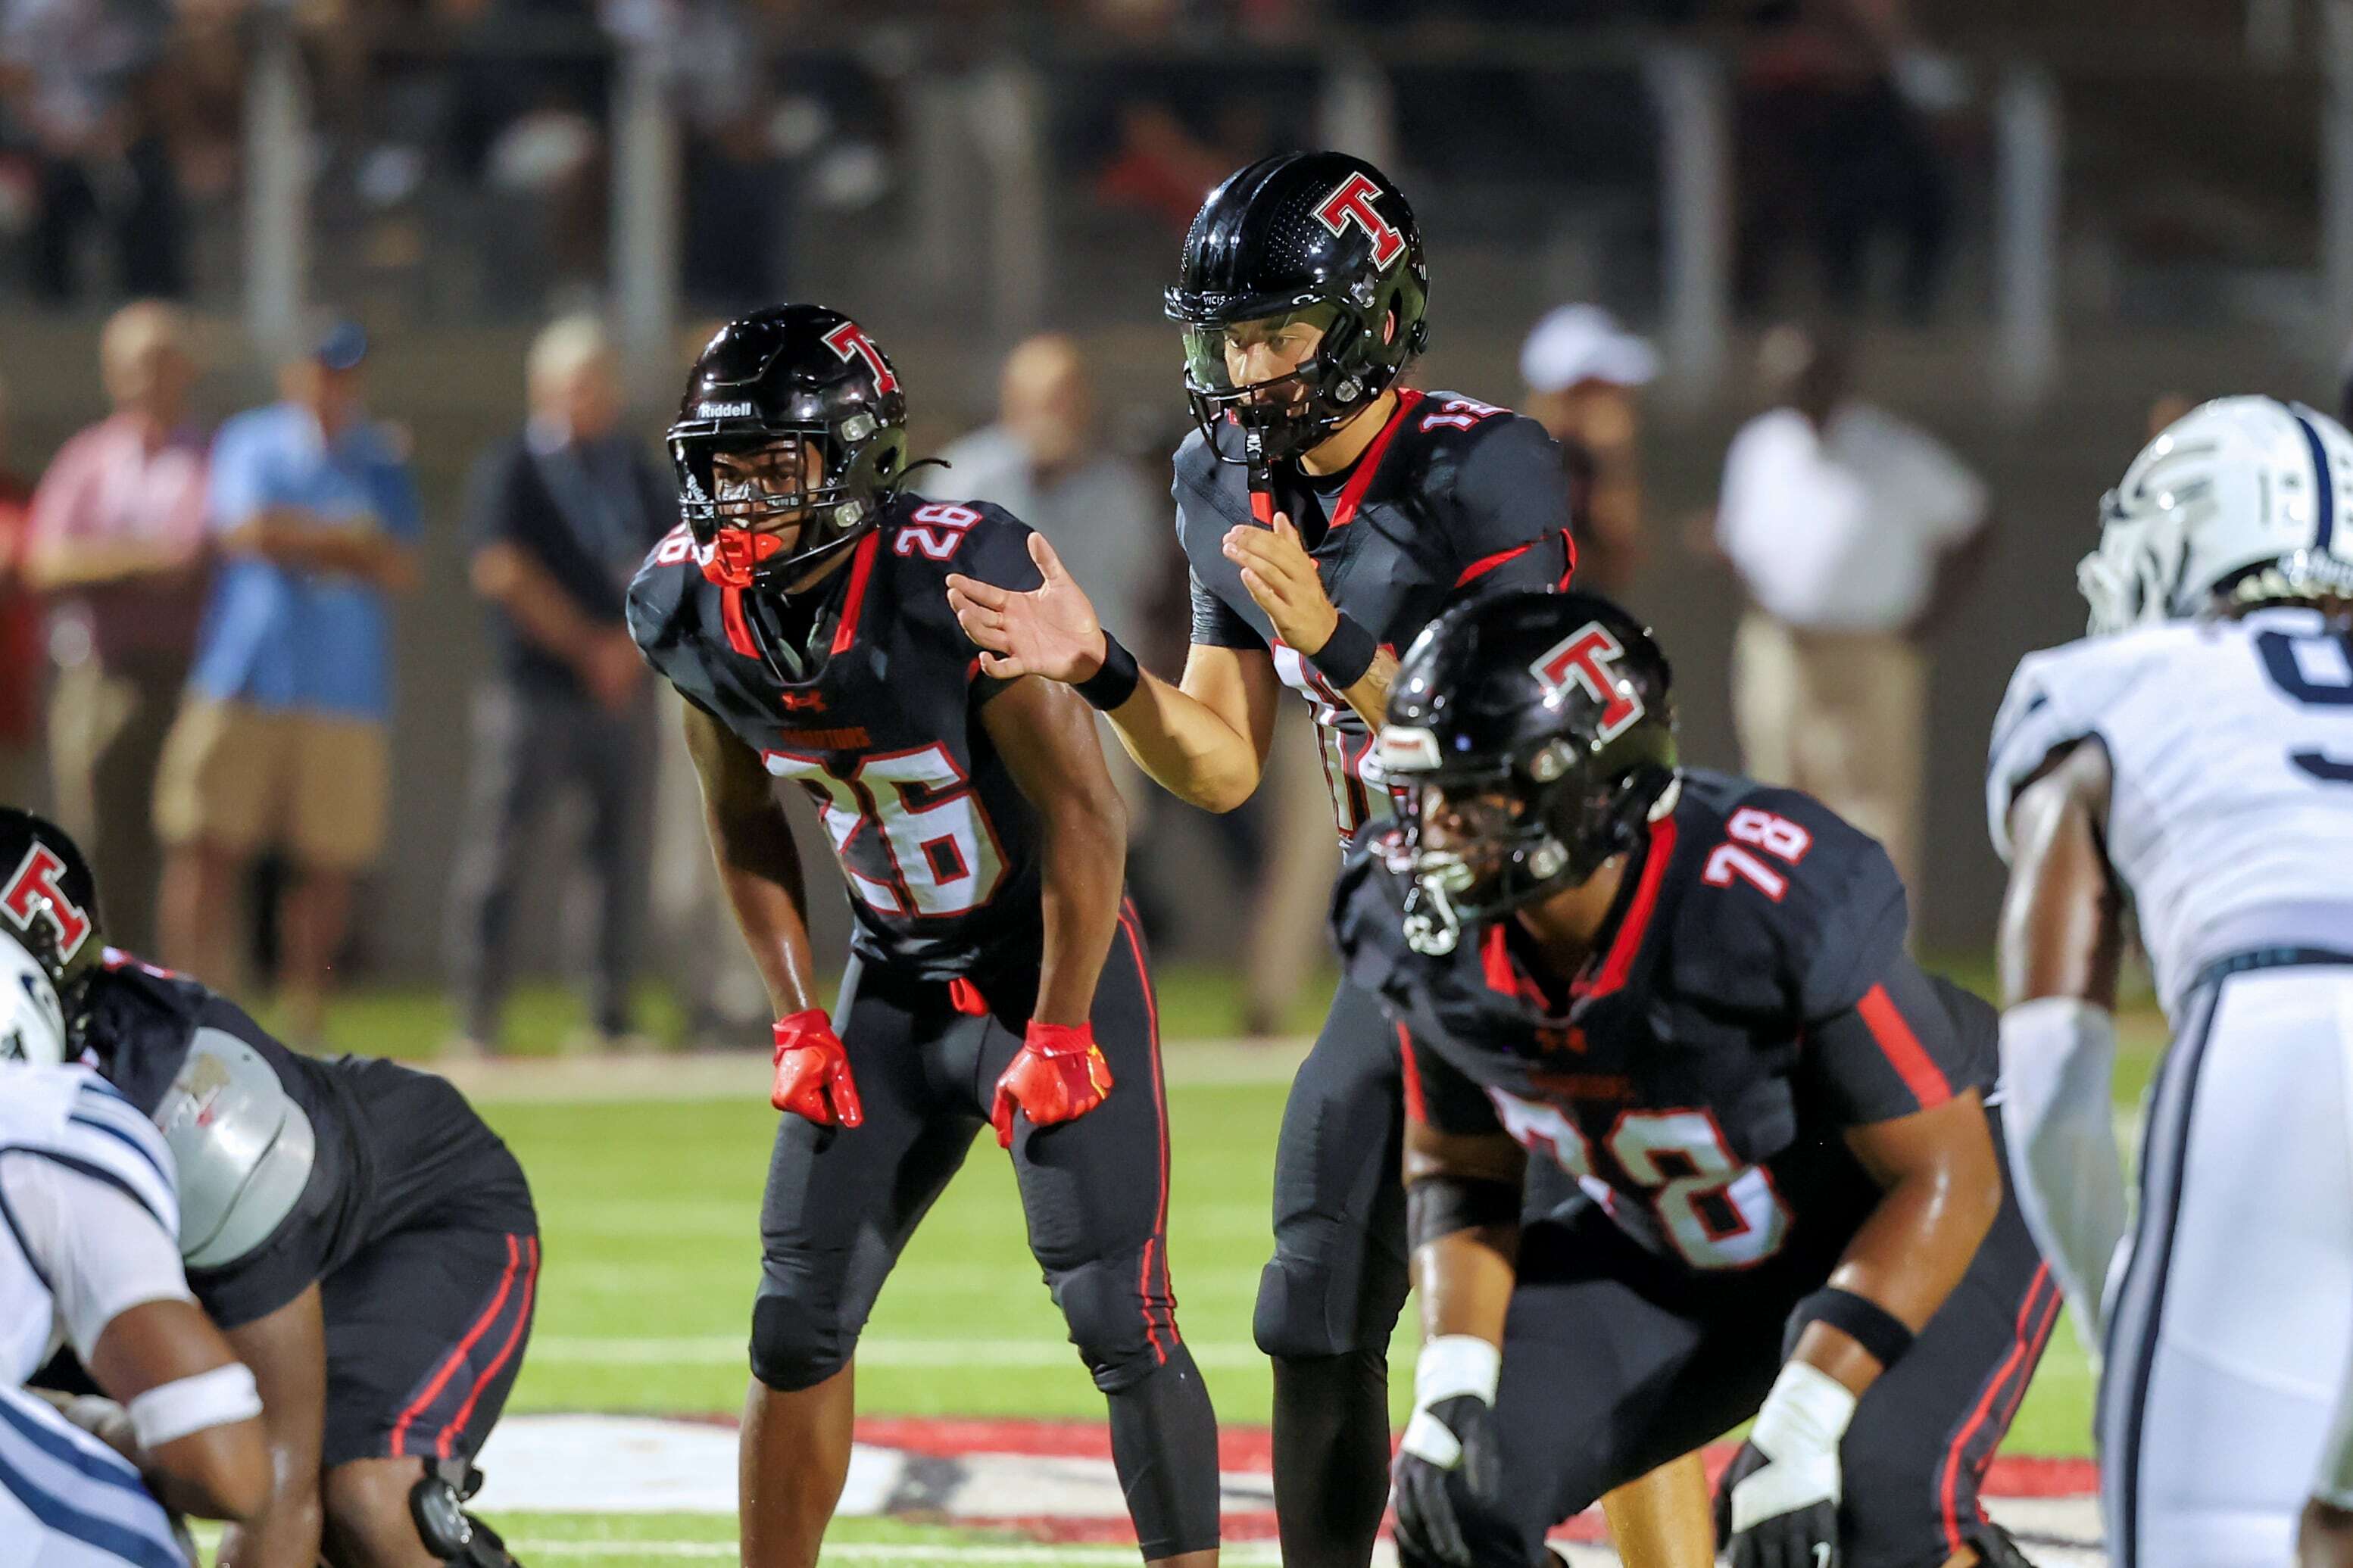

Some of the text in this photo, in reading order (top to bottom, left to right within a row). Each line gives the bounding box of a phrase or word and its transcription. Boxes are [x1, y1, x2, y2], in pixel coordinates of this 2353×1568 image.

[1312, 170, 1406, 273] T
[1203, 295, 1226, 306] VICIS
[820, 320, 900, 399] T
[701, 402, 752, 417] Riddell
[1418, 398, 1514, 434] 12
[892, 502, 983, 562] 26
[1528, 620, 1645, 744] T
[762, 740, 1010, 918] 26
[1700, 805, 1815, 903] 78
[0, 840, 92, 965] T
[1484, 1084, 1795, 1270] 78
